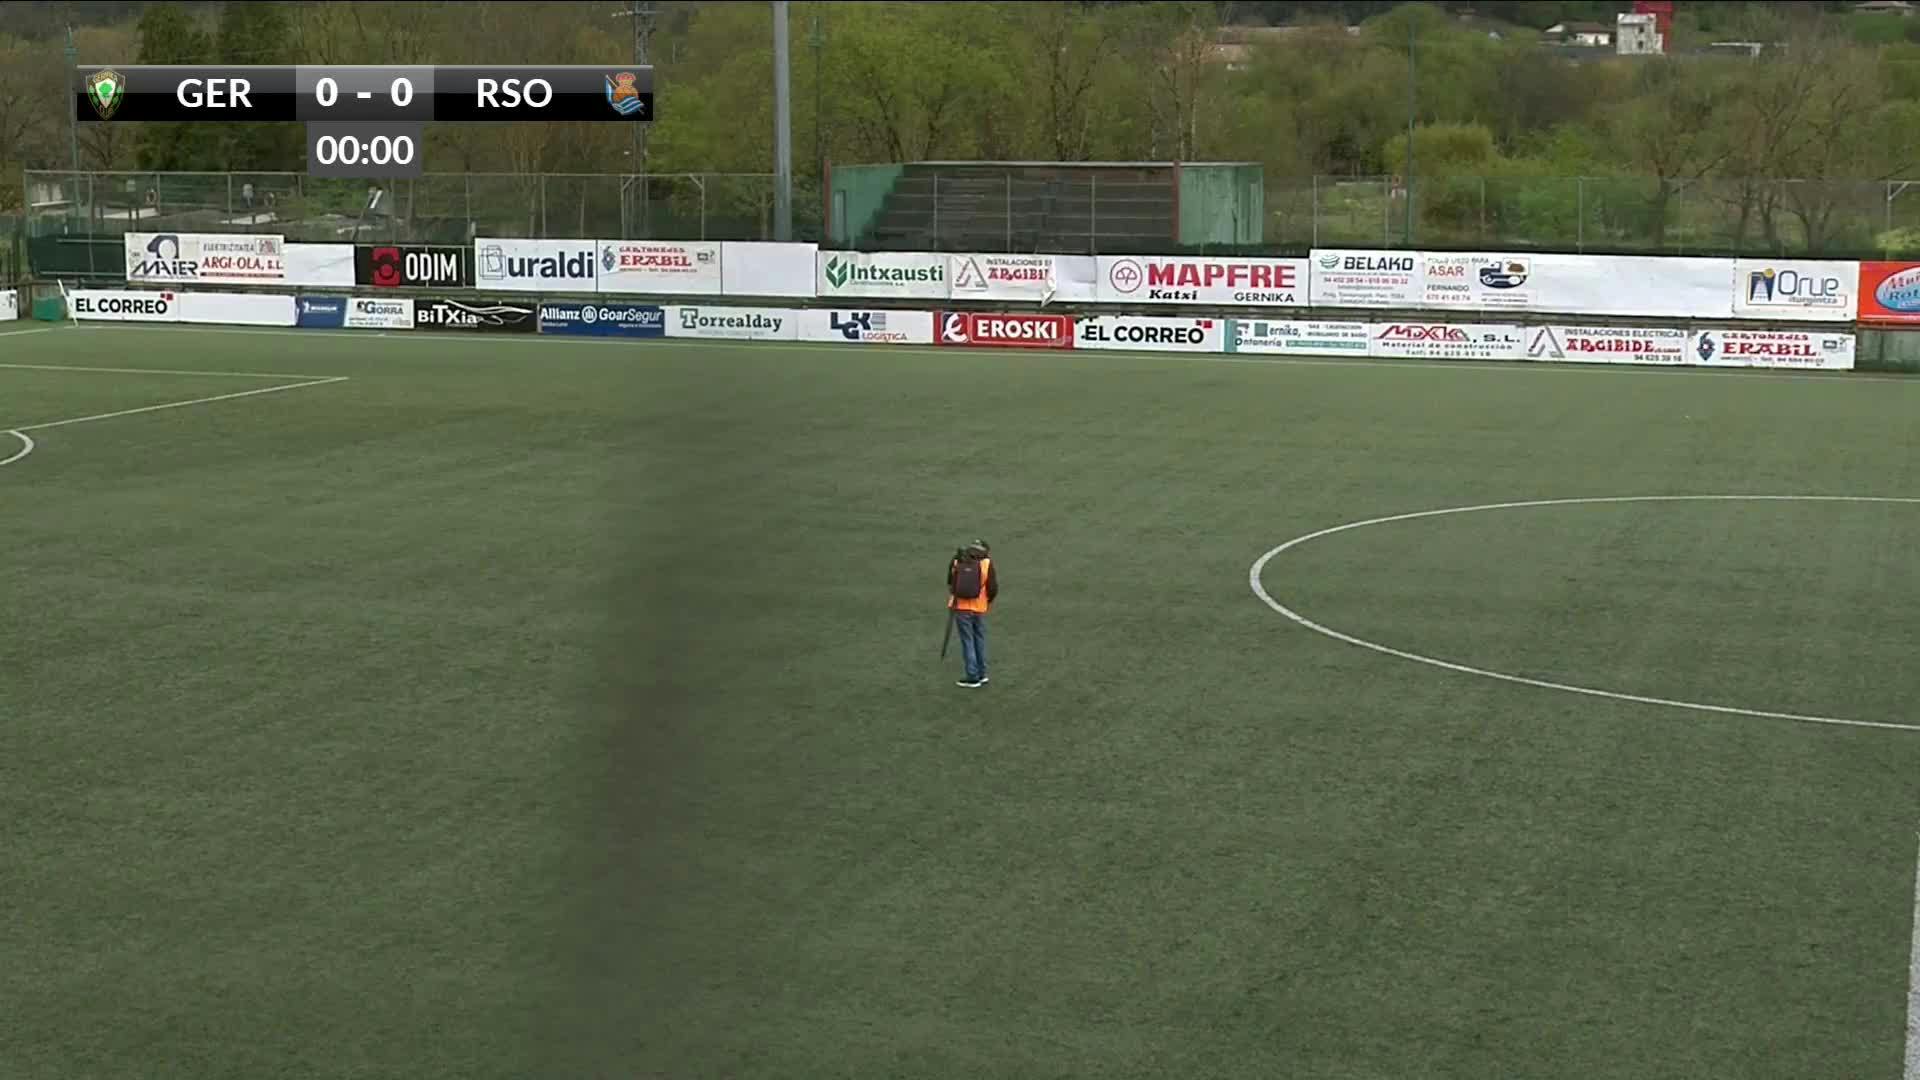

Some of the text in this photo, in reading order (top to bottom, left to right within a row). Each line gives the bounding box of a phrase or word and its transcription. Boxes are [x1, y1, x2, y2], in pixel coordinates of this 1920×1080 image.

[405, 253, 457, 281] ODIM
[1344, 256, 1414, 271] BELAKO
[1428, 265, 1465, 277] ASAR
[850, 263, 943, 281] Intxausti
[1148, 263, 1296, 288] MAPFRE
[1427, 284, 1470, 292] FERNANDO
[1777, 270, 1839, 297] Orue
[1149, 289, 1295, 303] Katxi GERNIKA
[76, 298, 168, 314] EL CORREO
[541, 308, 662, 324] Allianz GoarSegur
[680, 308, 782, 332] Torrealday
[976, 319, 1058, 339] EROSKI
[1085, 325, 1205, 344] EL CORREO
[1565, 328, 1685, 338] INSTALACIONES ELECTRICAS
[1382, 340, 1425, 348] Material
[1484, 333, 1520, 343] S.L.
